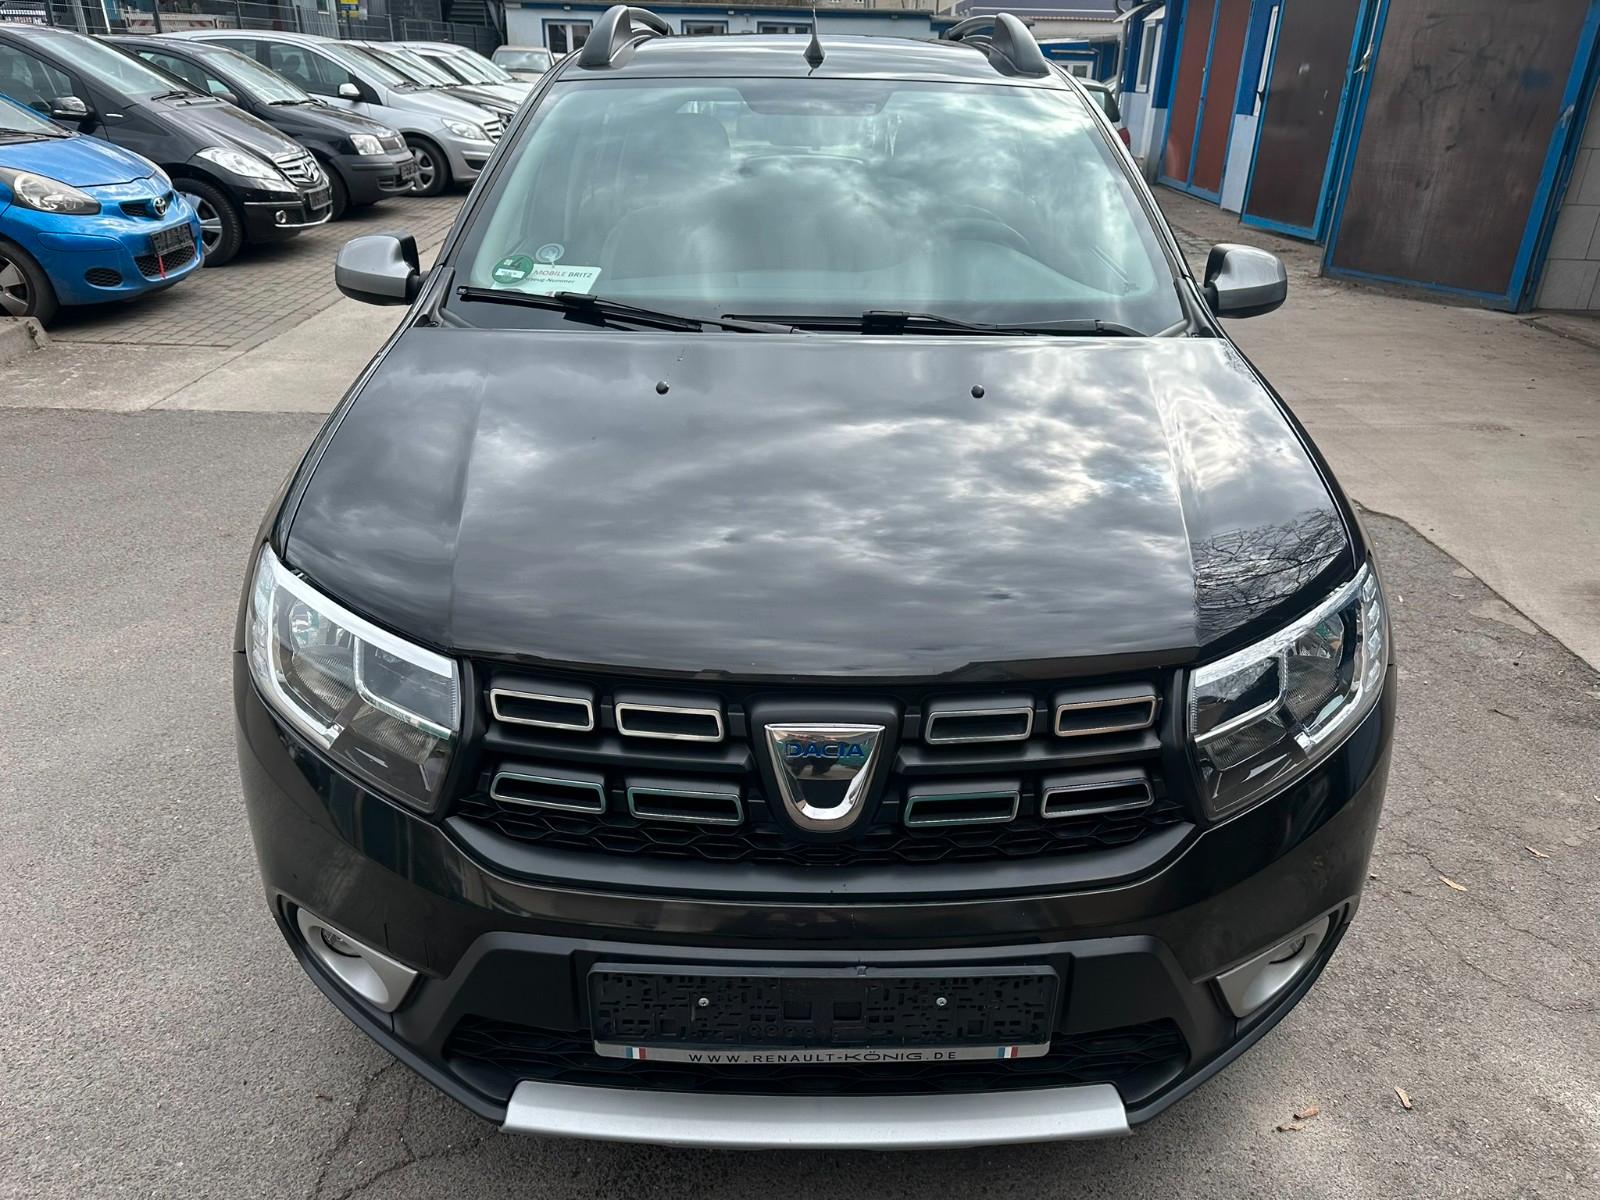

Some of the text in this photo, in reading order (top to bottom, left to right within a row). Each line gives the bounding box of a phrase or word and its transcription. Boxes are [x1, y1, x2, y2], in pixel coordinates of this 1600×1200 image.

[567, 271, 593, 279] BRITZ
[786, 742, 865, 758] DACIA
[688, 1050, 957, 1063] WWW.RENAULT-KÖNIG.DE
